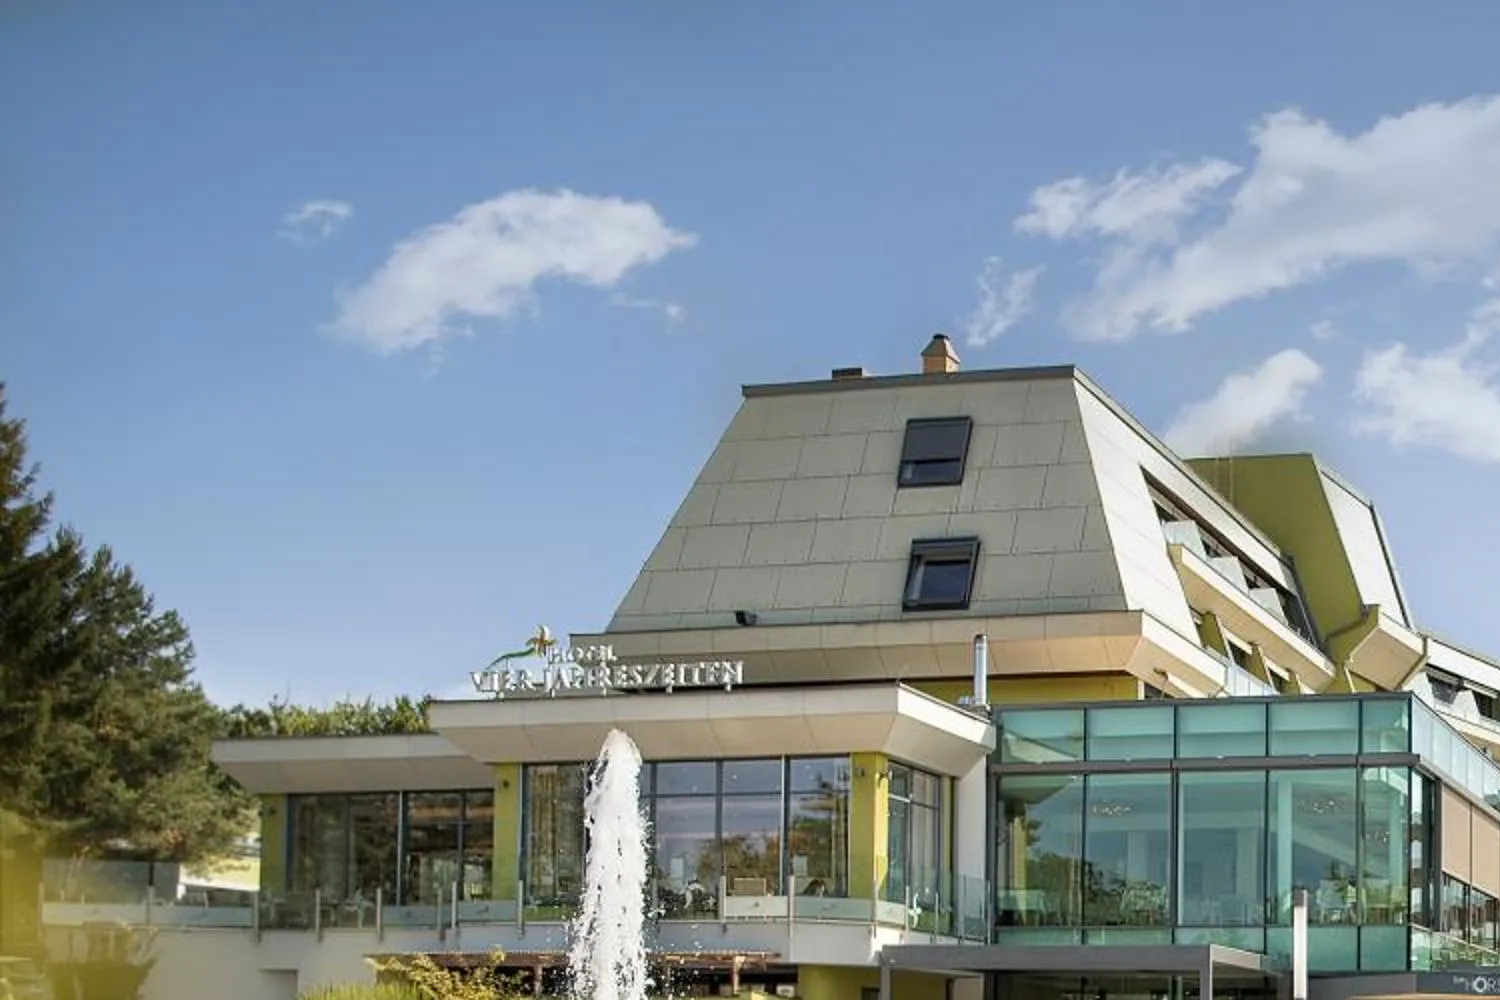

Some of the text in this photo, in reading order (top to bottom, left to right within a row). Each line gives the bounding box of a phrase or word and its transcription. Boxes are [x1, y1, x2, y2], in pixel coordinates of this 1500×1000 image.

[548, 645, 617, 662] HOTEL
[469, 661, 743, 692] VIER JAHRESZEITEN
